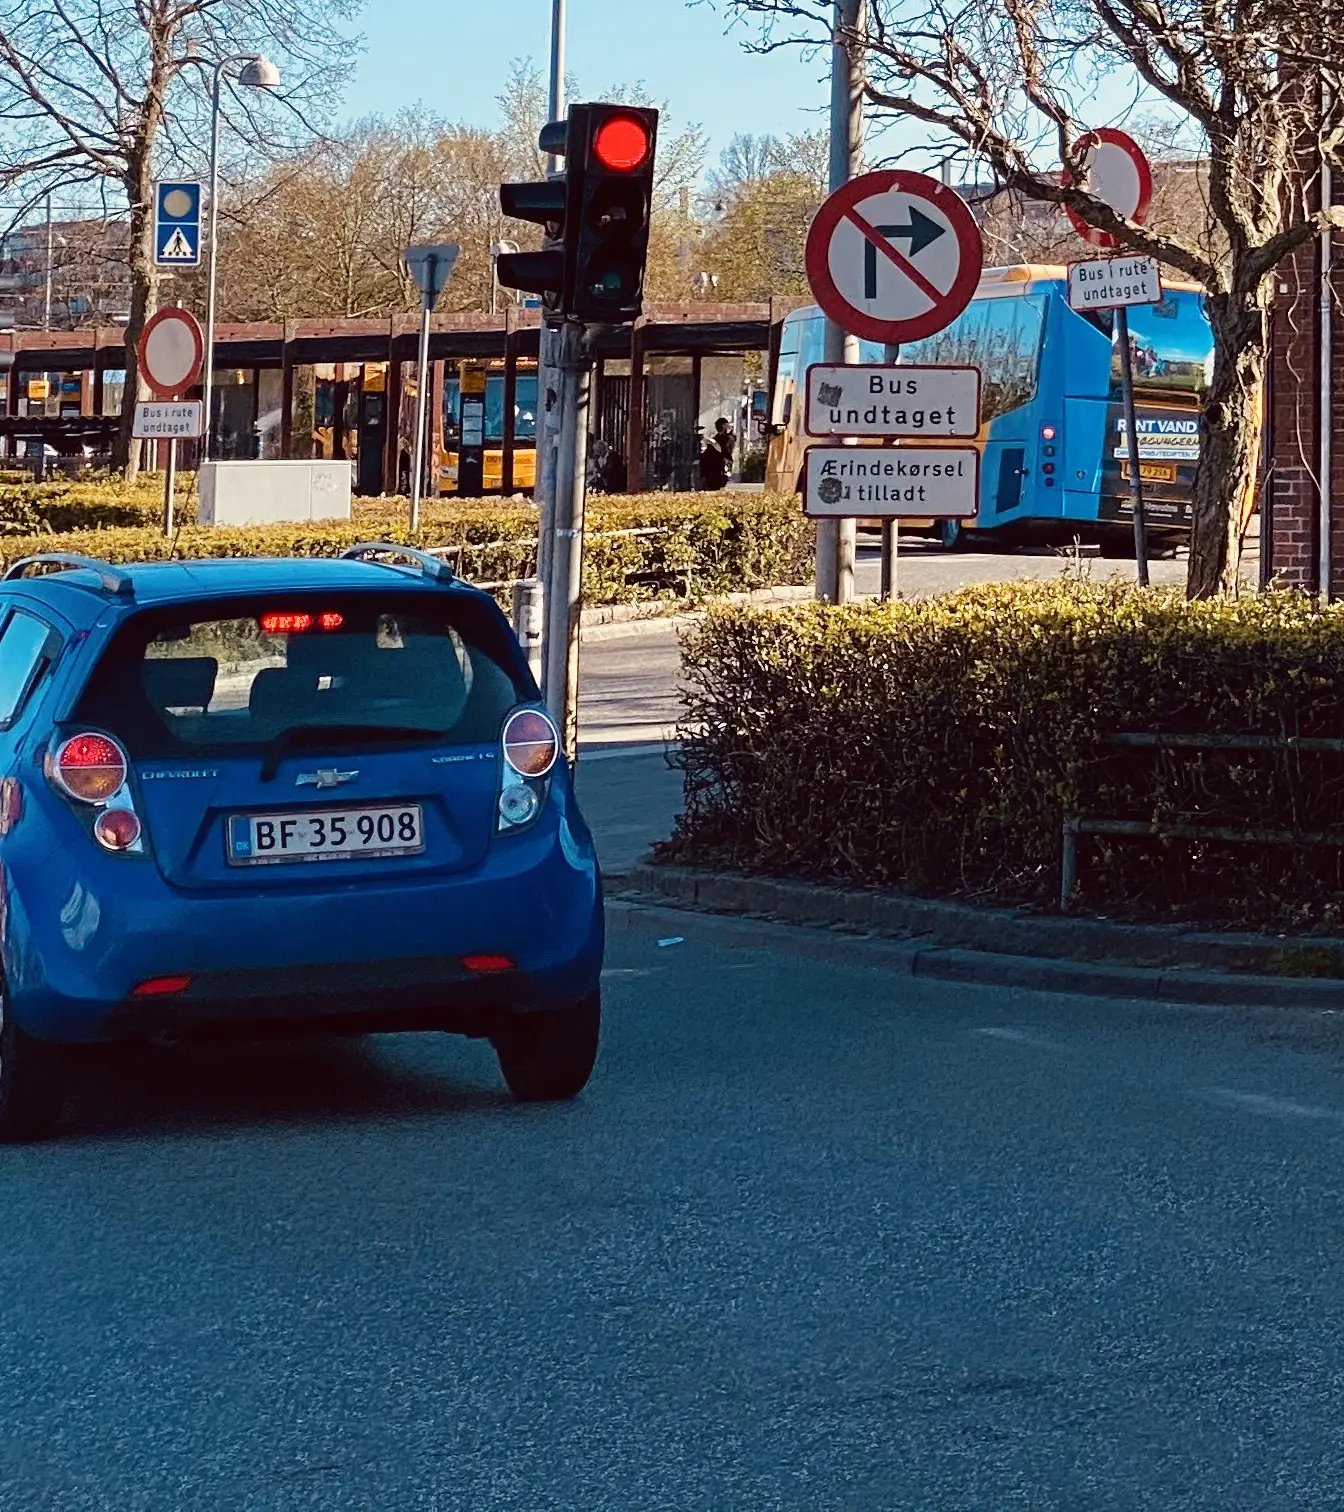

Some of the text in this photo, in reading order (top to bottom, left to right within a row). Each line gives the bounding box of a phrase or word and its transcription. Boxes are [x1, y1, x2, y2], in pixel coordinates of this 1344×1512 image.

[1079, 263, 1147, 282] Bus i rute
[1083, 281, 1147, 301] undtaget
[869, 375, 918, 395] Bus
[142, 407, 162, 418] Bus
[171, 407, 193, 418] rute
[829, 405, 956, 429] undtaget
[143, 421, 190, 435] undtaget
[1117, 418, 1198, 433] RNT VAND
[820, 460, 964, 477] Ærindekørsel
[857, 485, 927, 502] tilladt
[141, 769, 218, 780] CHEVROLET
[256, 811, 417, 850] BF 35 908
